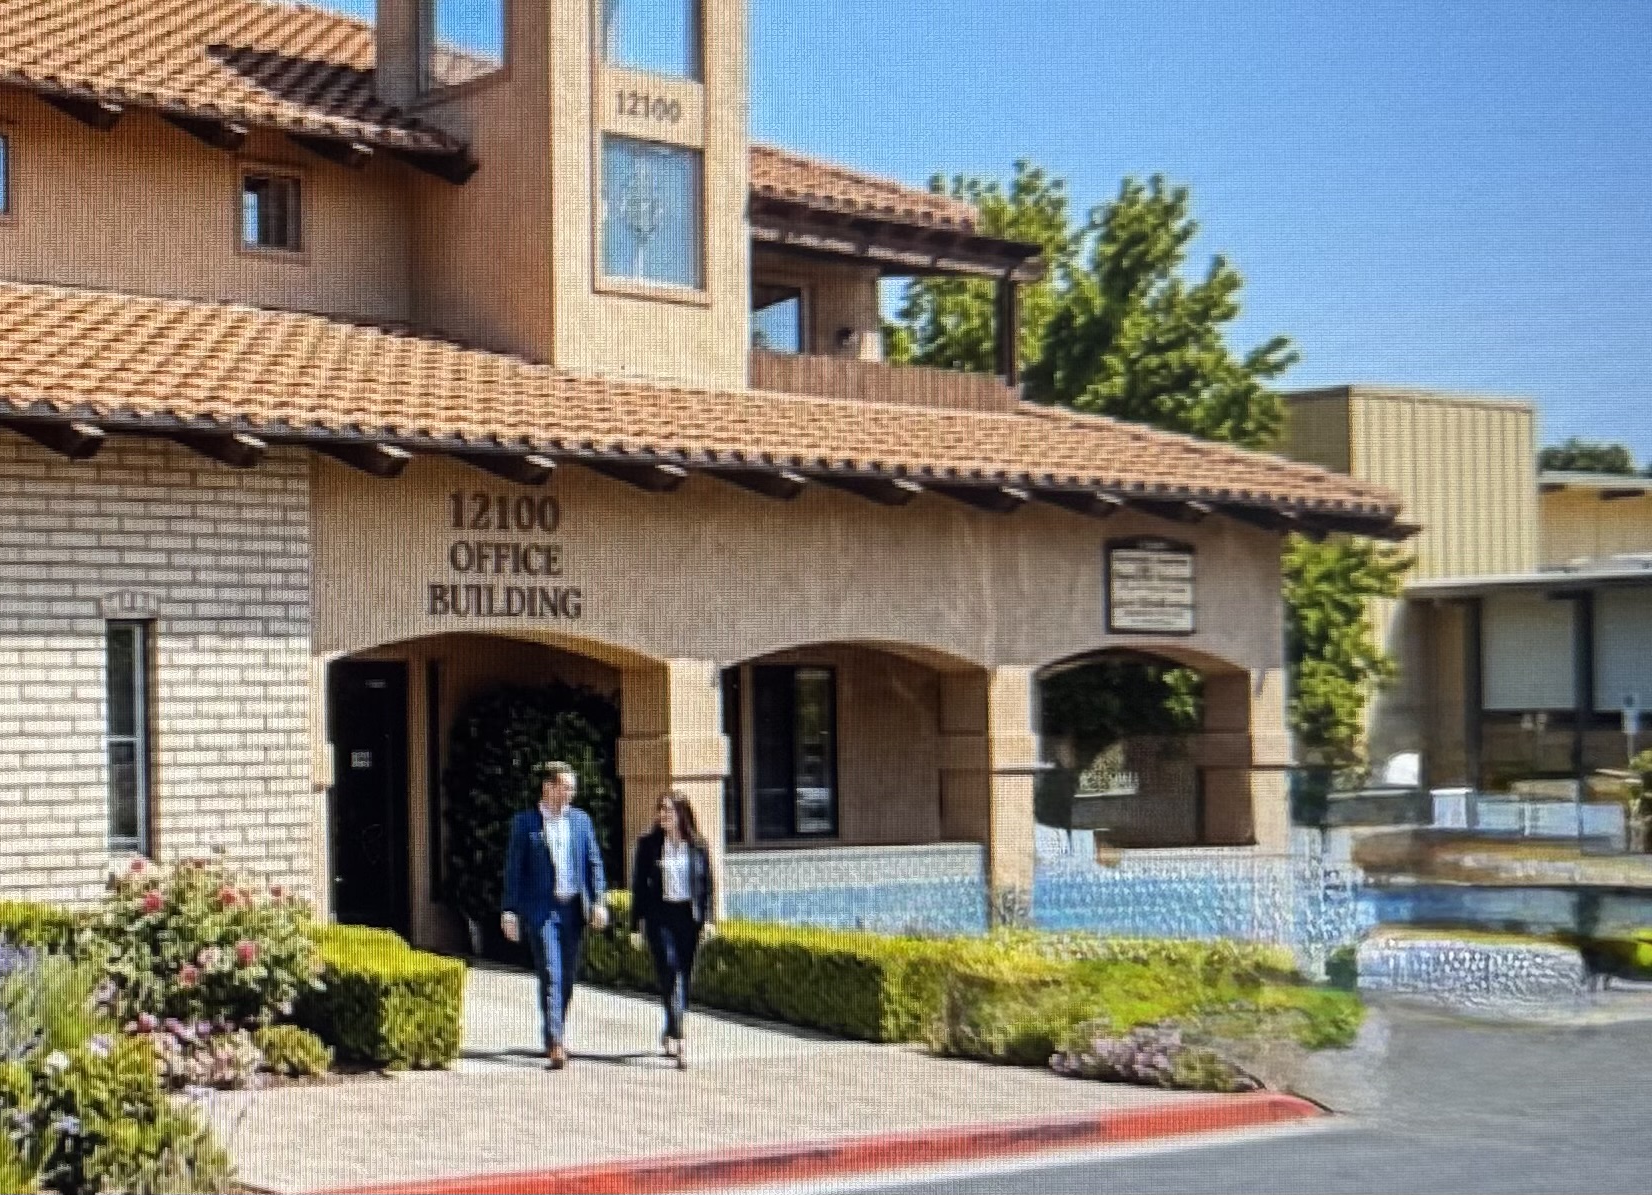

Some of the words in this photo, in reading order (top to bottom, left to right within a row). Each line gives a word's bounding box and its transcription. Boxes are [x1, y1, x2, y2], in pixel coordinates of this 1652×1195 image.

[615, 90, 681, 123] 12100
[450, 493, 560, 532] 12100
[450, 540, 563, 576] OFFICE
[429, 584, 582, 619] BUILDING
